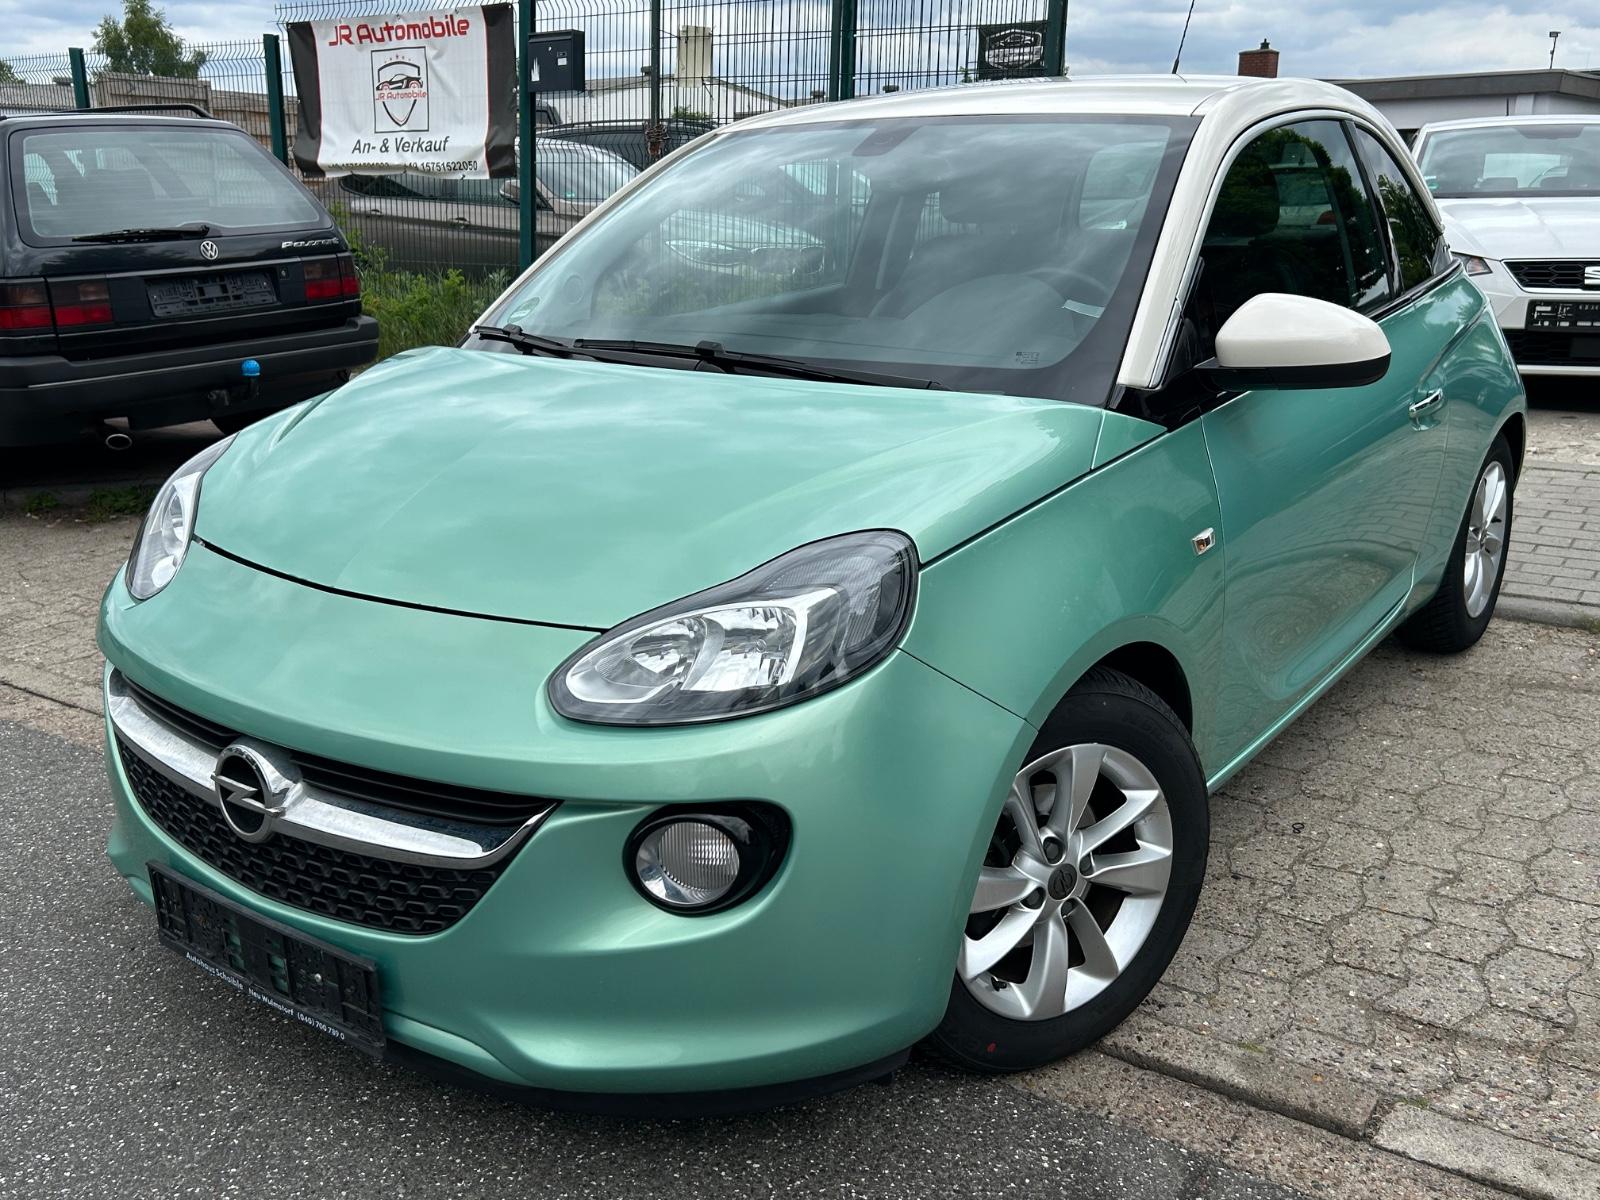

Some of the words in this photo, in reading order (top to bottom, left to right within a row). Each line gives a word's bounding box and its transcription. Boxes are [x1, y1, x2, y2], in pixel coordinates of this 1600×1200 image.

[329, 24, 354, 46] JR
[356, 14, 470, 44] Automobile
[351, 139, 376, 154] An-
[380, 137, 390, 153] &
[394, 136, 451, 153] Verkauf
